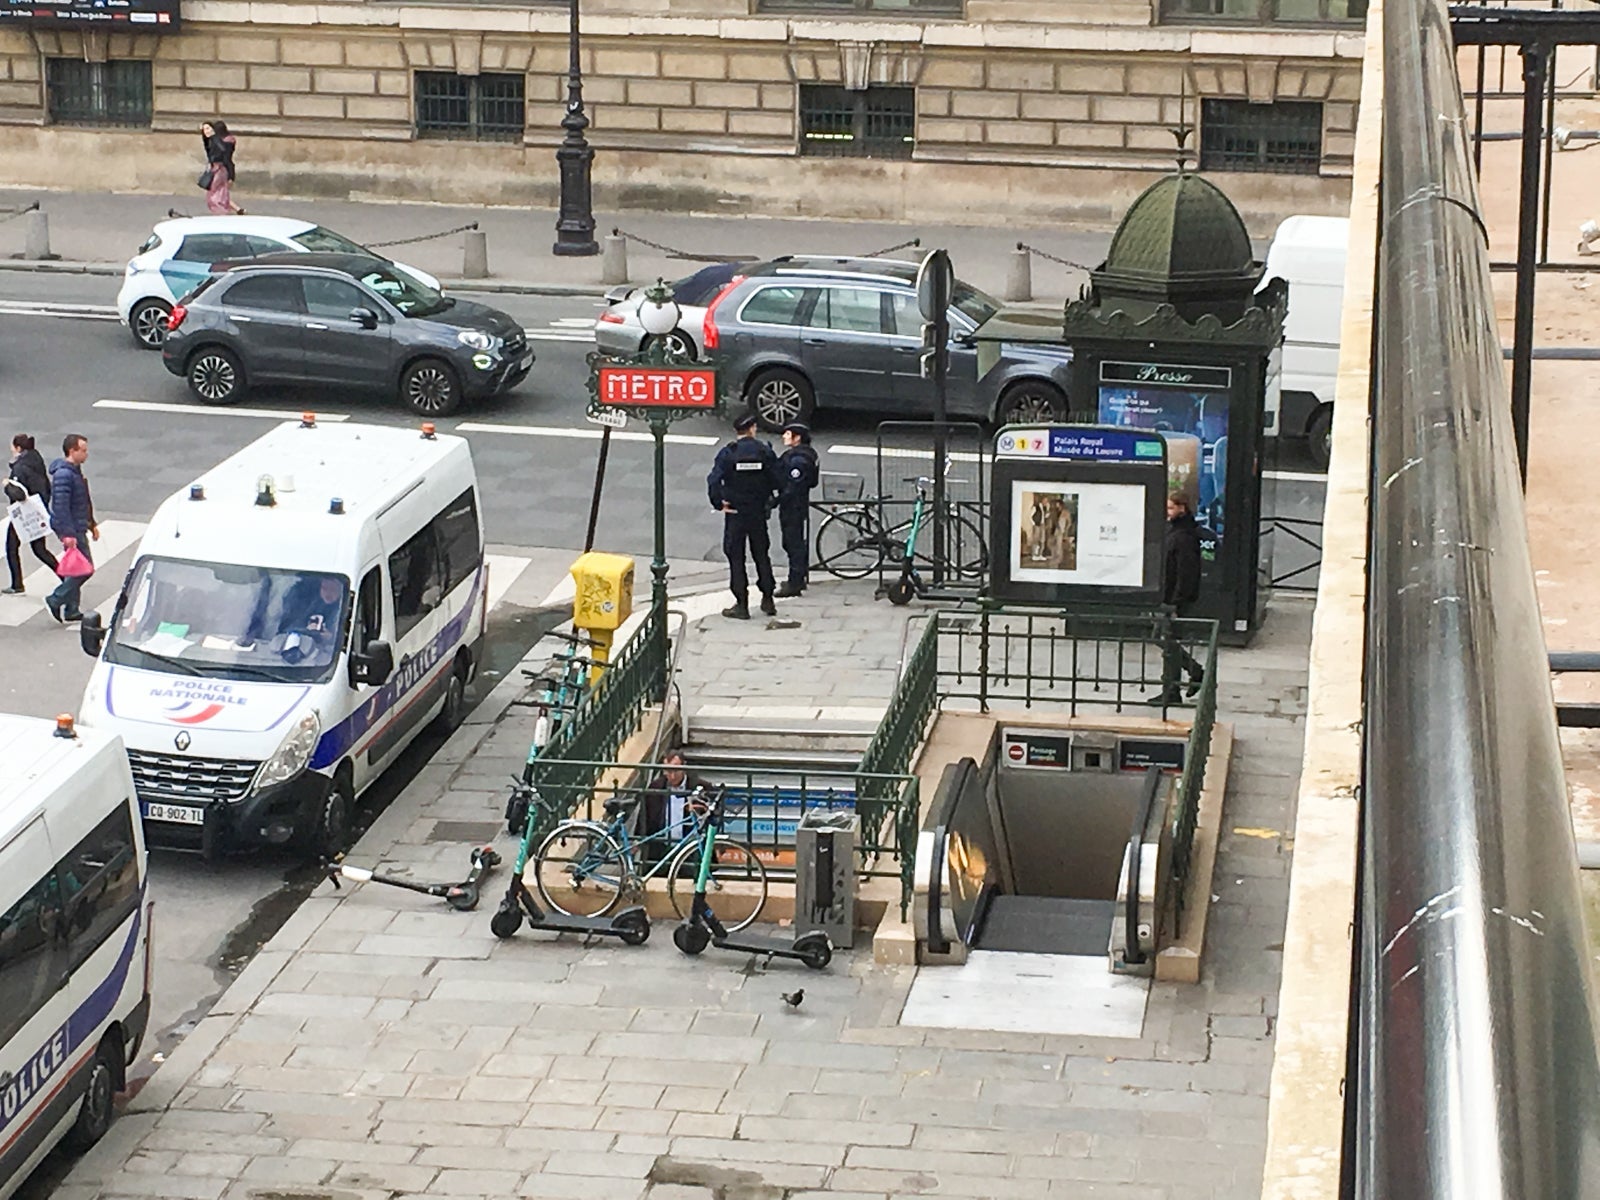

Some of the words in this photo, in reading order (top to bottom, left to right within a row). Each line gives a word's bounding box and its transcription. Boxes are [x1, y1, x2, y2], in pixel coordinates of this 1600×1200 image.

[1136, 366, 1193, 382] Presse
[607, 374, 708, 401] METRO
[1034, 440, 1043, 450] 7
[1053, 436, 1079, 446] Palais
[1080, 437, 1104, 449] Royal
[1053, 445, 1081, 455] Musée
[1082, 446, 1094, 455] du
[1095, 446, 1124, 456] Louvre
[396, 637, 438, 698] POLICE
[173, 680, 233, 693] POLICE
[150, 688, 248, 706] NATIONALE
[0, 1030, 63, 1119] OLICE
